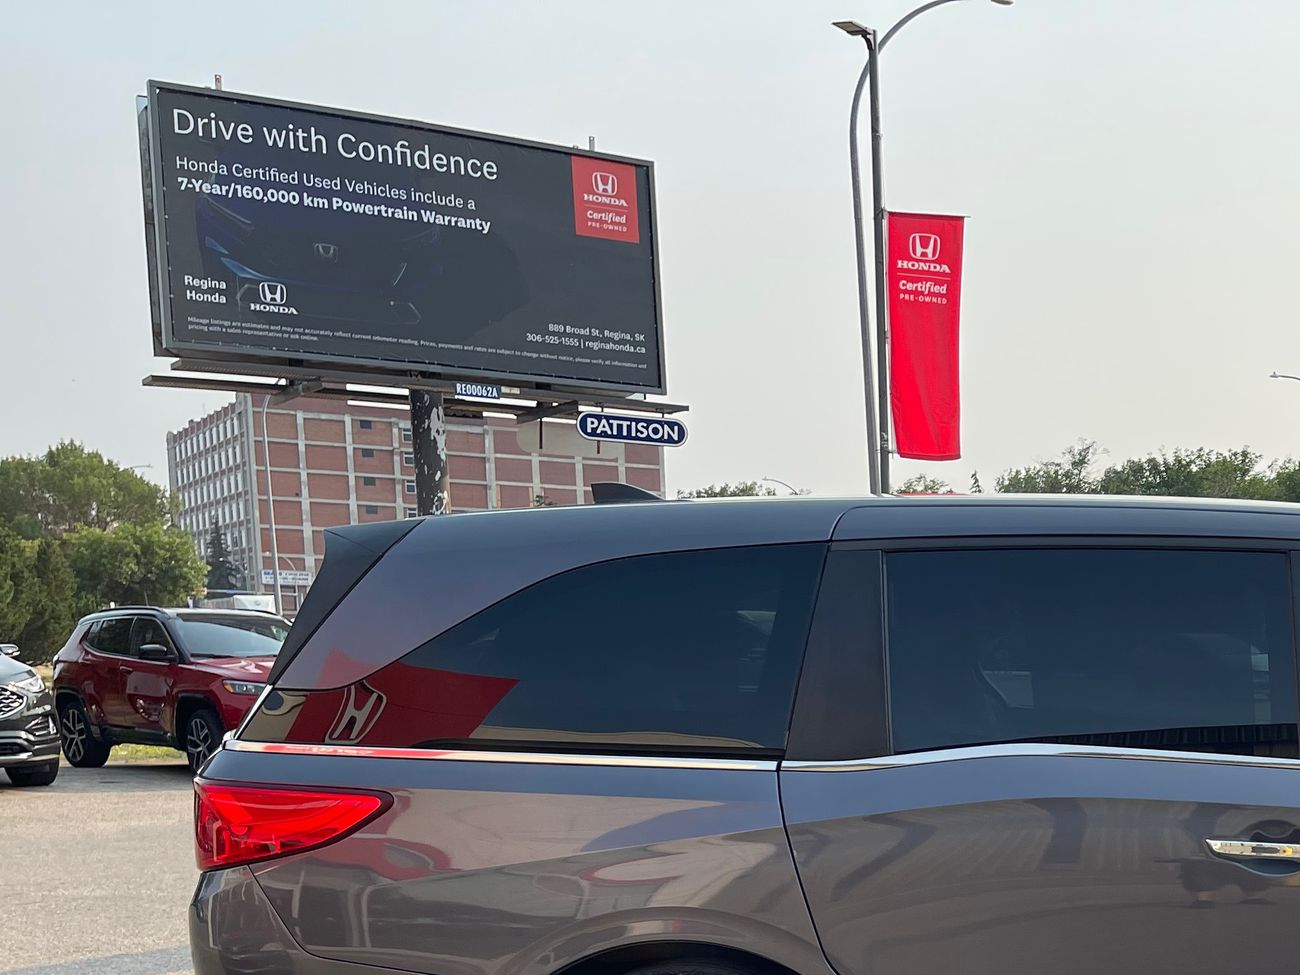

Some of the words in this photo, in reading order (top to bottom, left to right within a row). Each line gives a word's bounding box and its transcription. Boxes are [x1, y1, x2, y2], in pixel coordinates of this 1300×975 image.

[172, 108, 253, 143] Drive
[263, 124, 327, 154] with
[337, 133, 498, 180] Confidence
[176, 156, 228, 176] Honda
[232, 163, 298, 185] Certified
[303, 173, 341, 191] Used
[345, 178, 407, 200] Vehicles
[410, 188, 464, 207] include
[467, 199, 476, 210] a
[177, 177, 299, 205] 7-Year/160,000
[303, 192, 329, 209] km
[332, 199, 418, 222] Powertrain
[421, 210, 491, 234] Warranty
[584, 193, 628, 207] HONDA
[587, 210, 626, 224] Certified
[587, 221, 627, 232] PRE-OWNED
[896, 259, 951, 274] HONDA
[184, 275, 226, 290] Regina
[899, 279, 947, 295] Certified
[186, 289, 226, 303] Honda
[899, 293, 948, 305] PRE-OWNED
[250, 303, 298, 315] HONDA
[548, 323, 564, 333] 889
[566, 325, 589, 335] Broad
[635, 333, 645, 341] SK
[526, 333, 579, 347] 306-525-1555
[585, 340, 646, 354] reginahonda.ca
[456, 383, 498, 398] RE00062A
[586, 417, 679, 441] PATTISON
